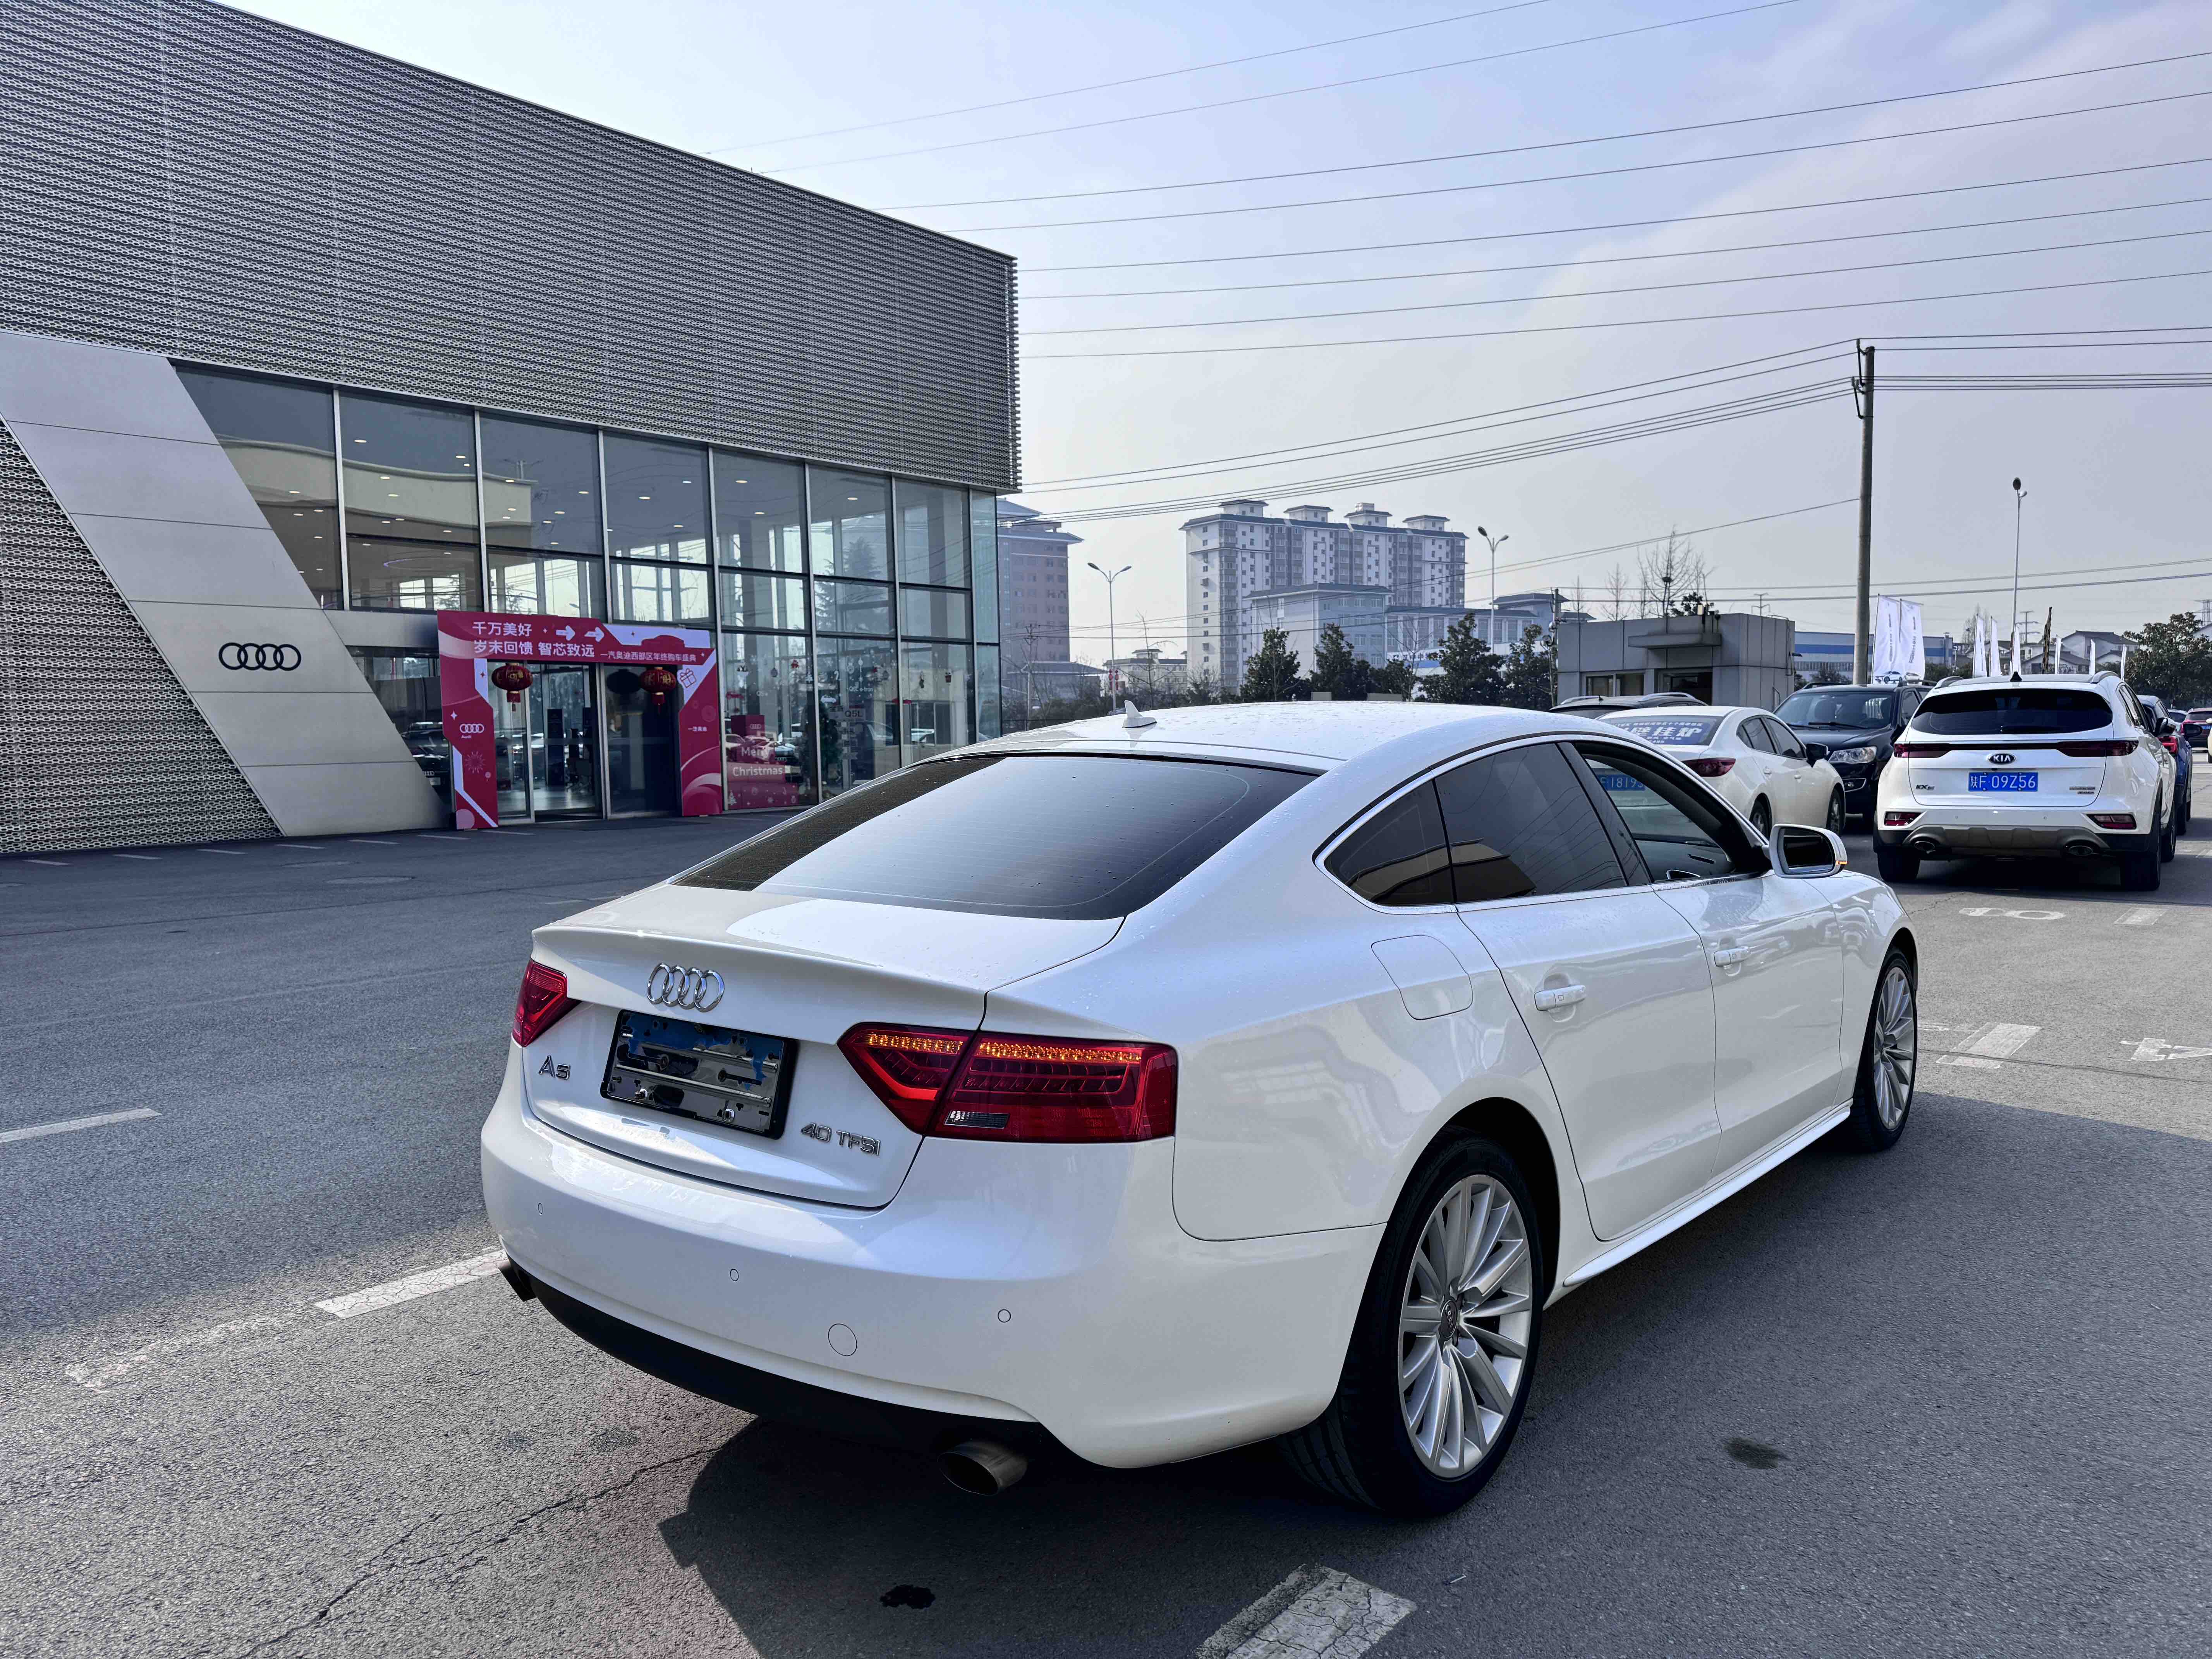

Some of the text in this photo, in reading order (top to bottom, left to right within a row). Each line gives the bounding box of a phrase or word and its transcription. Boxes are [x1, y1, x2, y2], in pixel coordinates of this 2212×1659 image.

[472, 621, 532, 637] 千万美好
[474, 640, 595, 658] 岁末回馈 智芯致远
[733, 766, 783, 776] Christmas
[539, 1054, 571, 1080] A5
[800, 1122, 881, 1157] 40 TFSI
